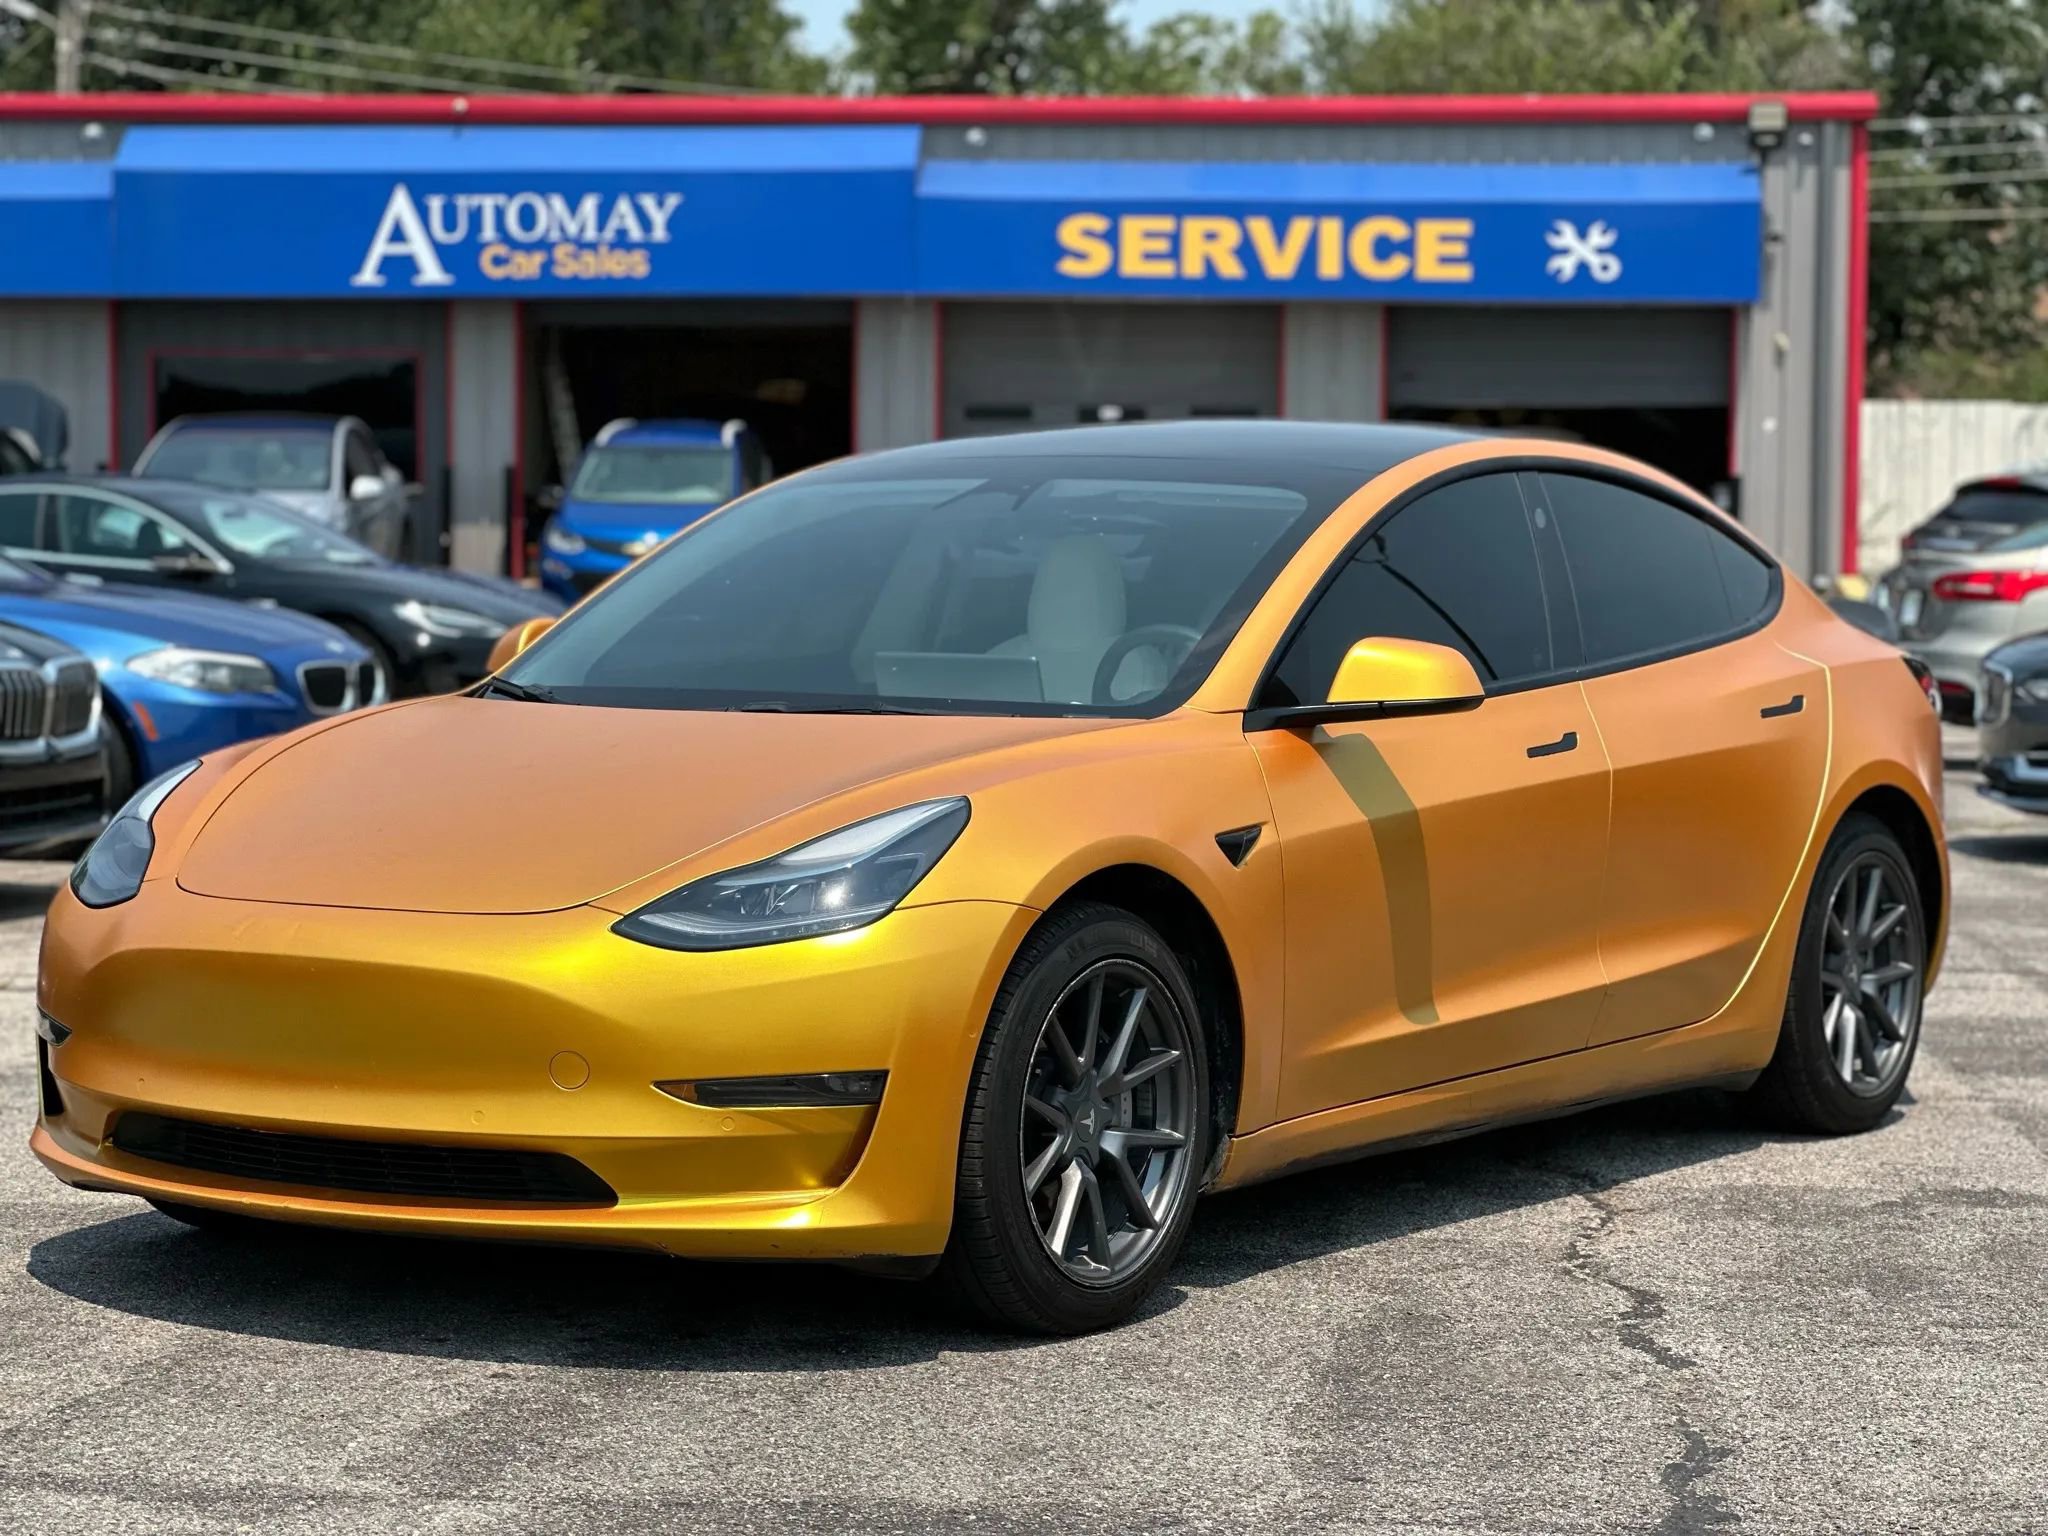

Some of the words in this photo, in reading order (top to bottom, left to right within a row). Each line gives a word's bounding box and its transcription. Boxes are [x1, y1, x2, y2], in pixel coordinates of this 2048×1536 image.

[350, 183, 682, 286] AUTOMAY
[479, 243, 547, 280] Car
[552, 242, 651, 279] Sales
[1055, 213, 1475, 282] SERVICE
